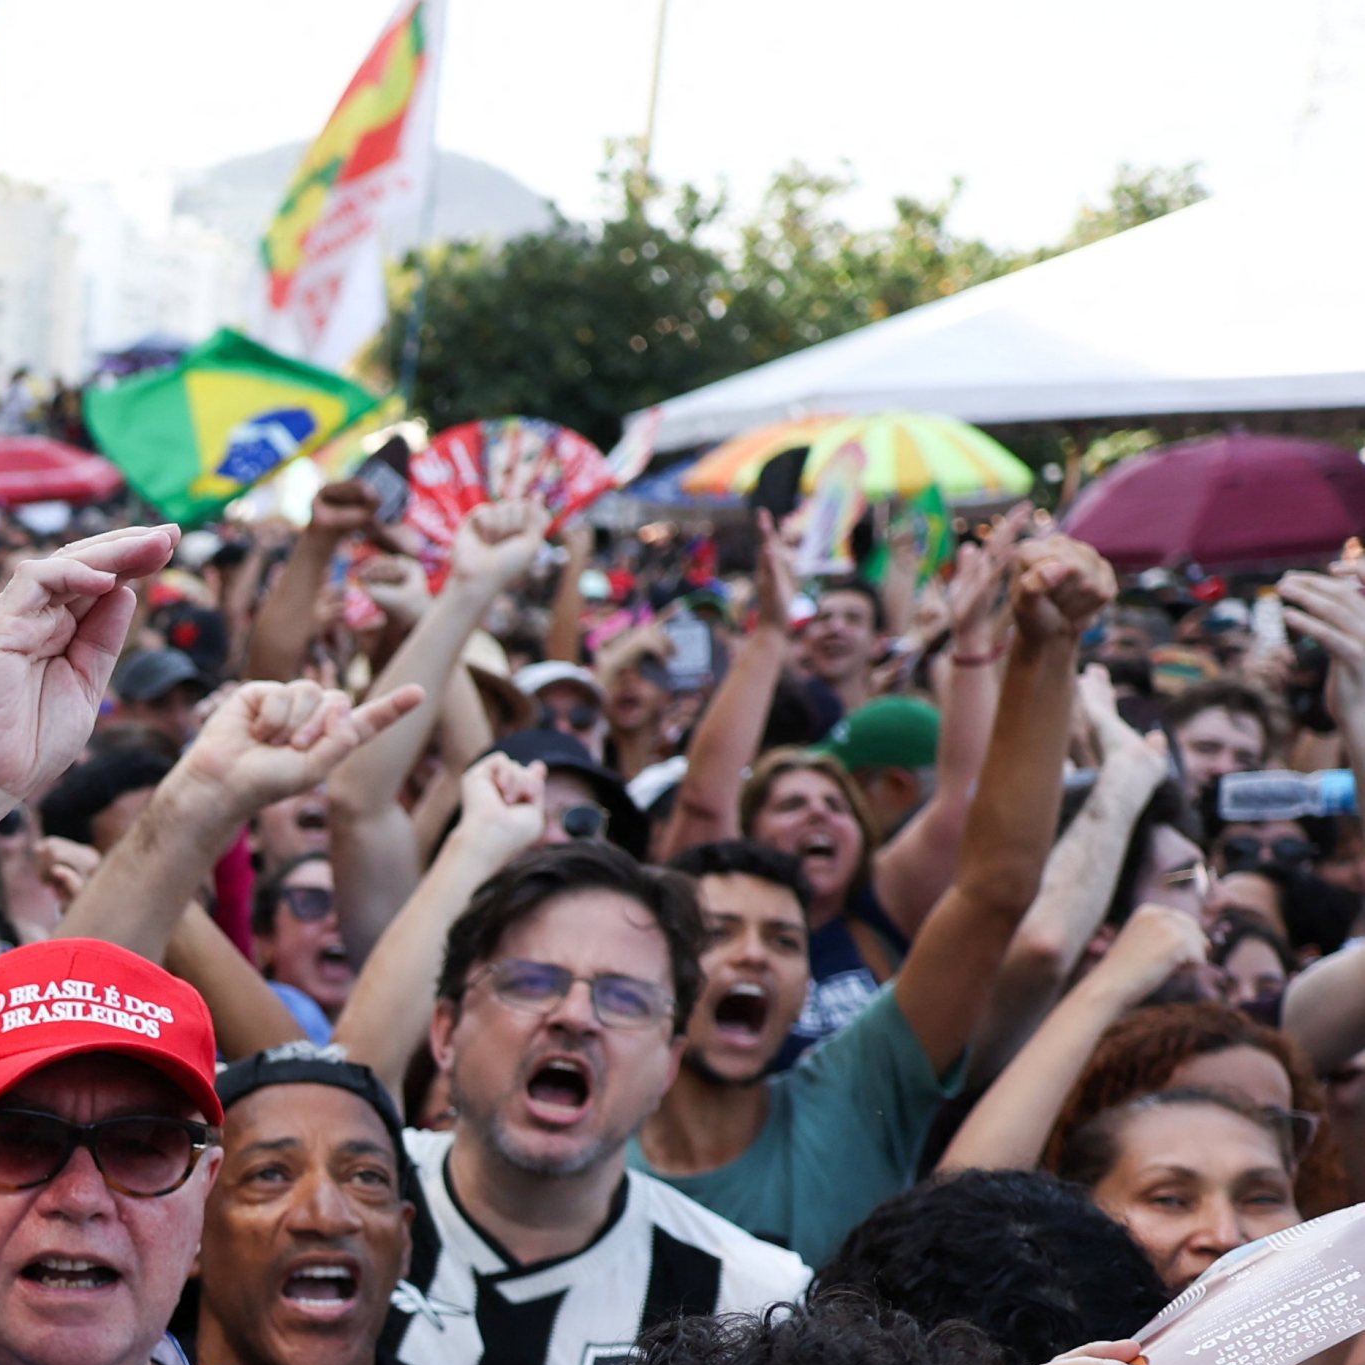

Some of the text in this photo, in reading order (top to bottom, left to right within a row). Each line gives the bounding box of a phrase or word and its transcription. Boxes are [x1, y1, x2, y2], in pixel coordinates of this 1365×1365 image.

[1, 1001, 160, 1039] BRASILEIROS
[8, 979, 101, 1008] BRASIL
[104, 985, 121, 1008] É
[123, 994, 174, 1023] DOS
[1186, 1271, 1362, 1356] #18CAMINHADA
[1217, 1292, 1348, 1357] democracia!
[1263, 1294, 1359, 1341] religiosa
[1306, 1307, 1365, 1340] orque
[1335, 1319, 1364, 1335] Eu
